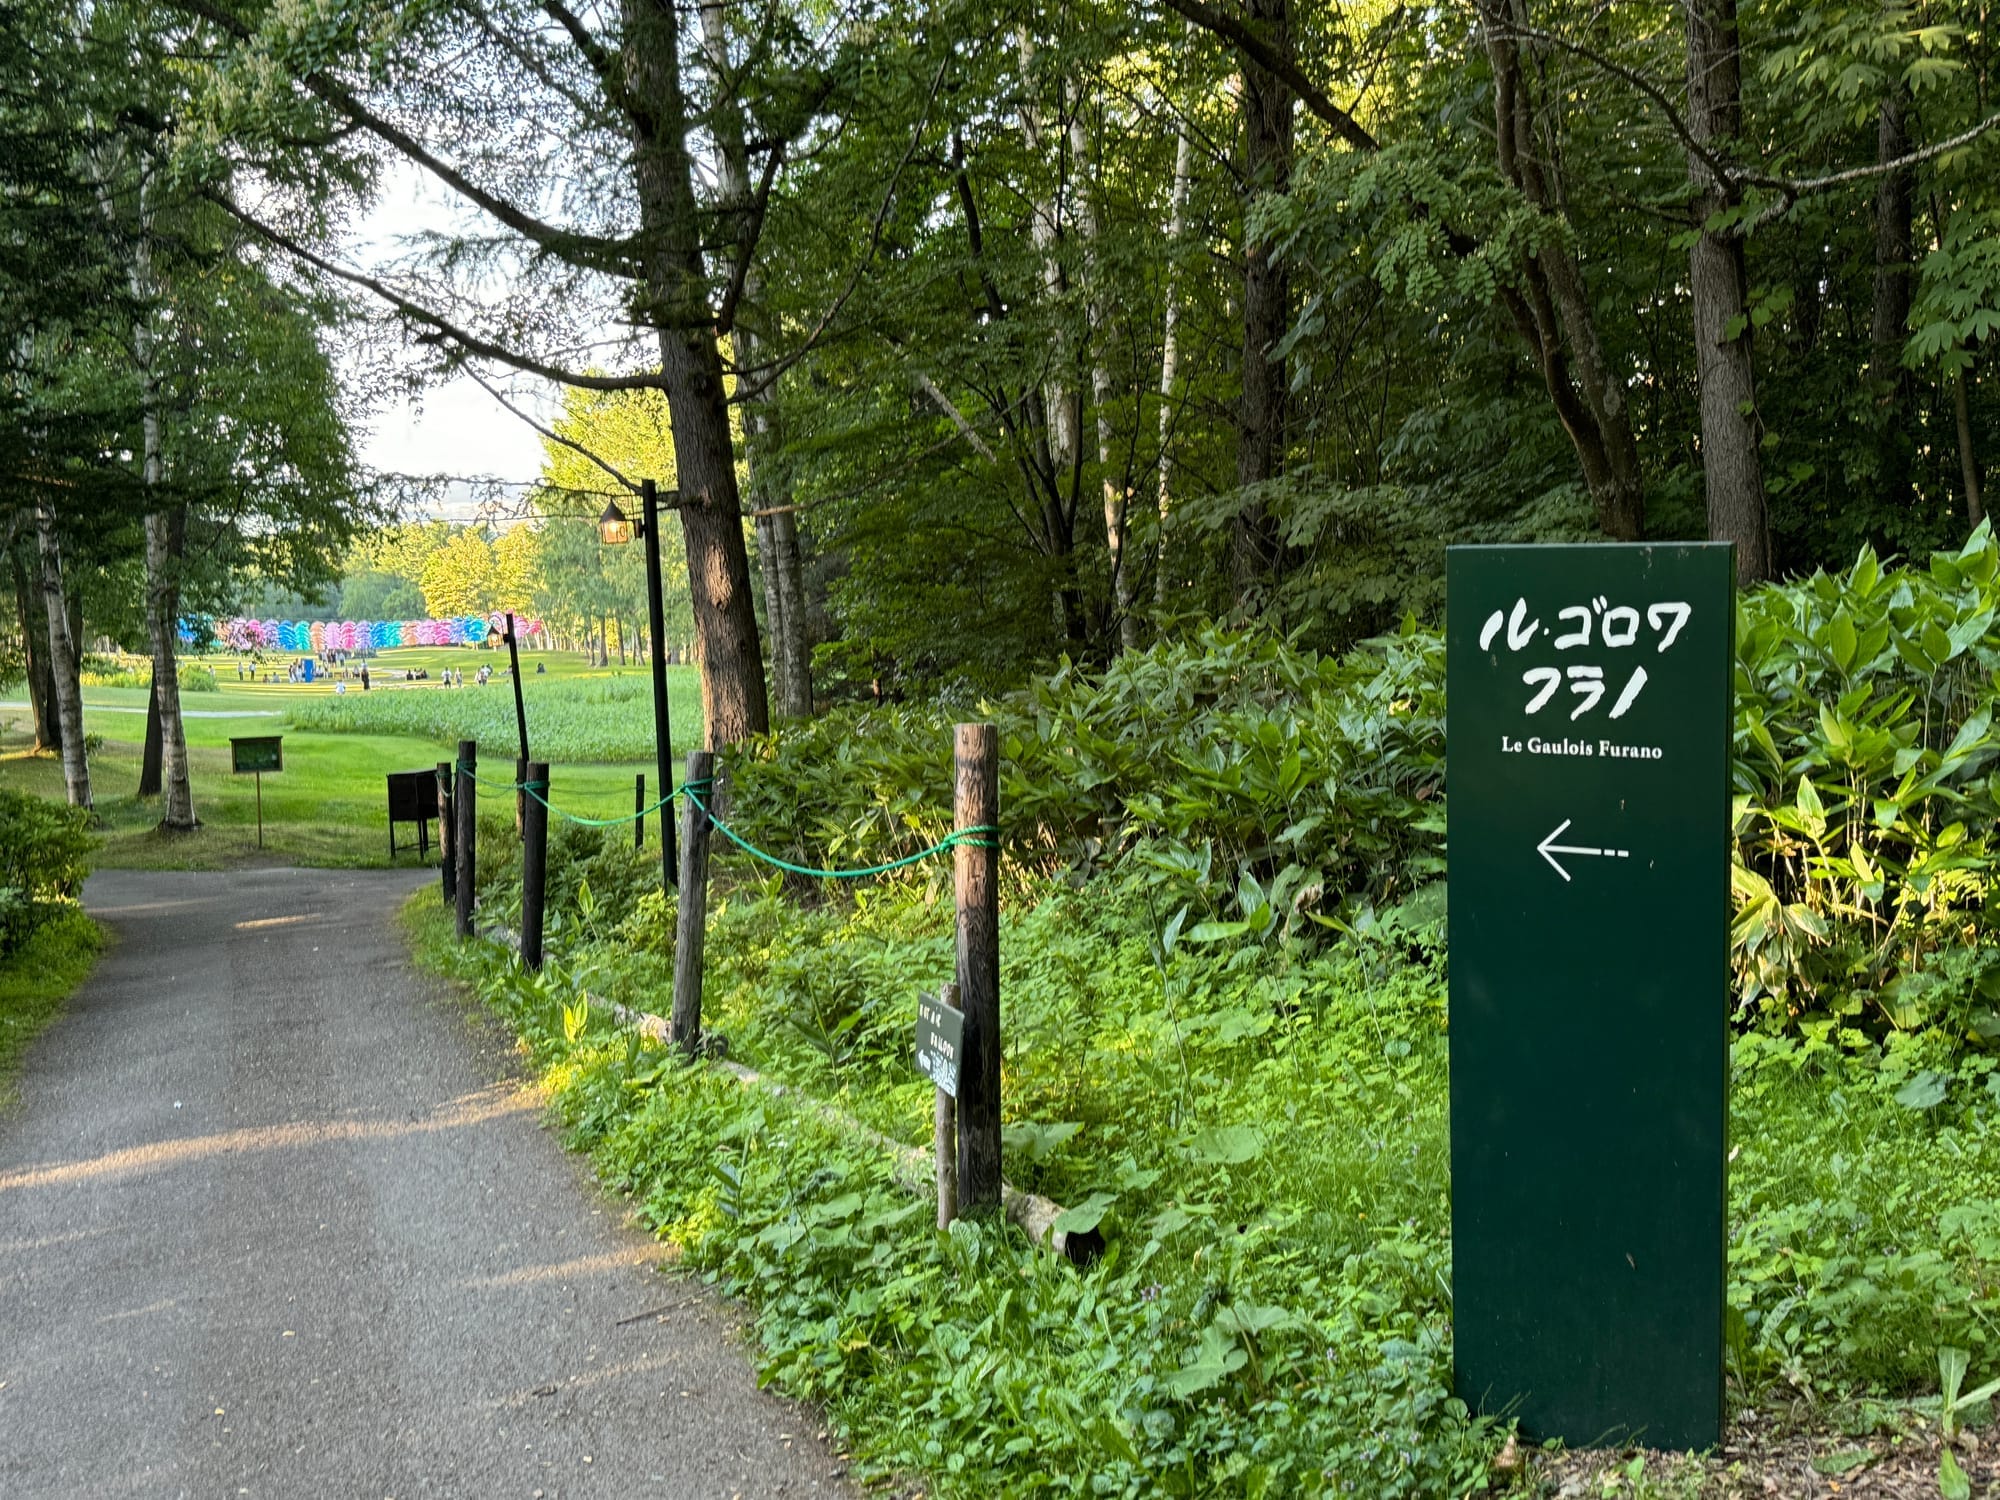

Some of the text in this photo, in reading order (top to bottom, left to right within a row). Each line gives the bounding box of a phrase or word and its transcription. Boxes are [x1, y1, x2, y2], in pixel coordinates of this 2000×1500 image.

[1522, 665, 1648, 721] フラノ
[1502, 736, 1663, 759] Le Gaulois Furano
